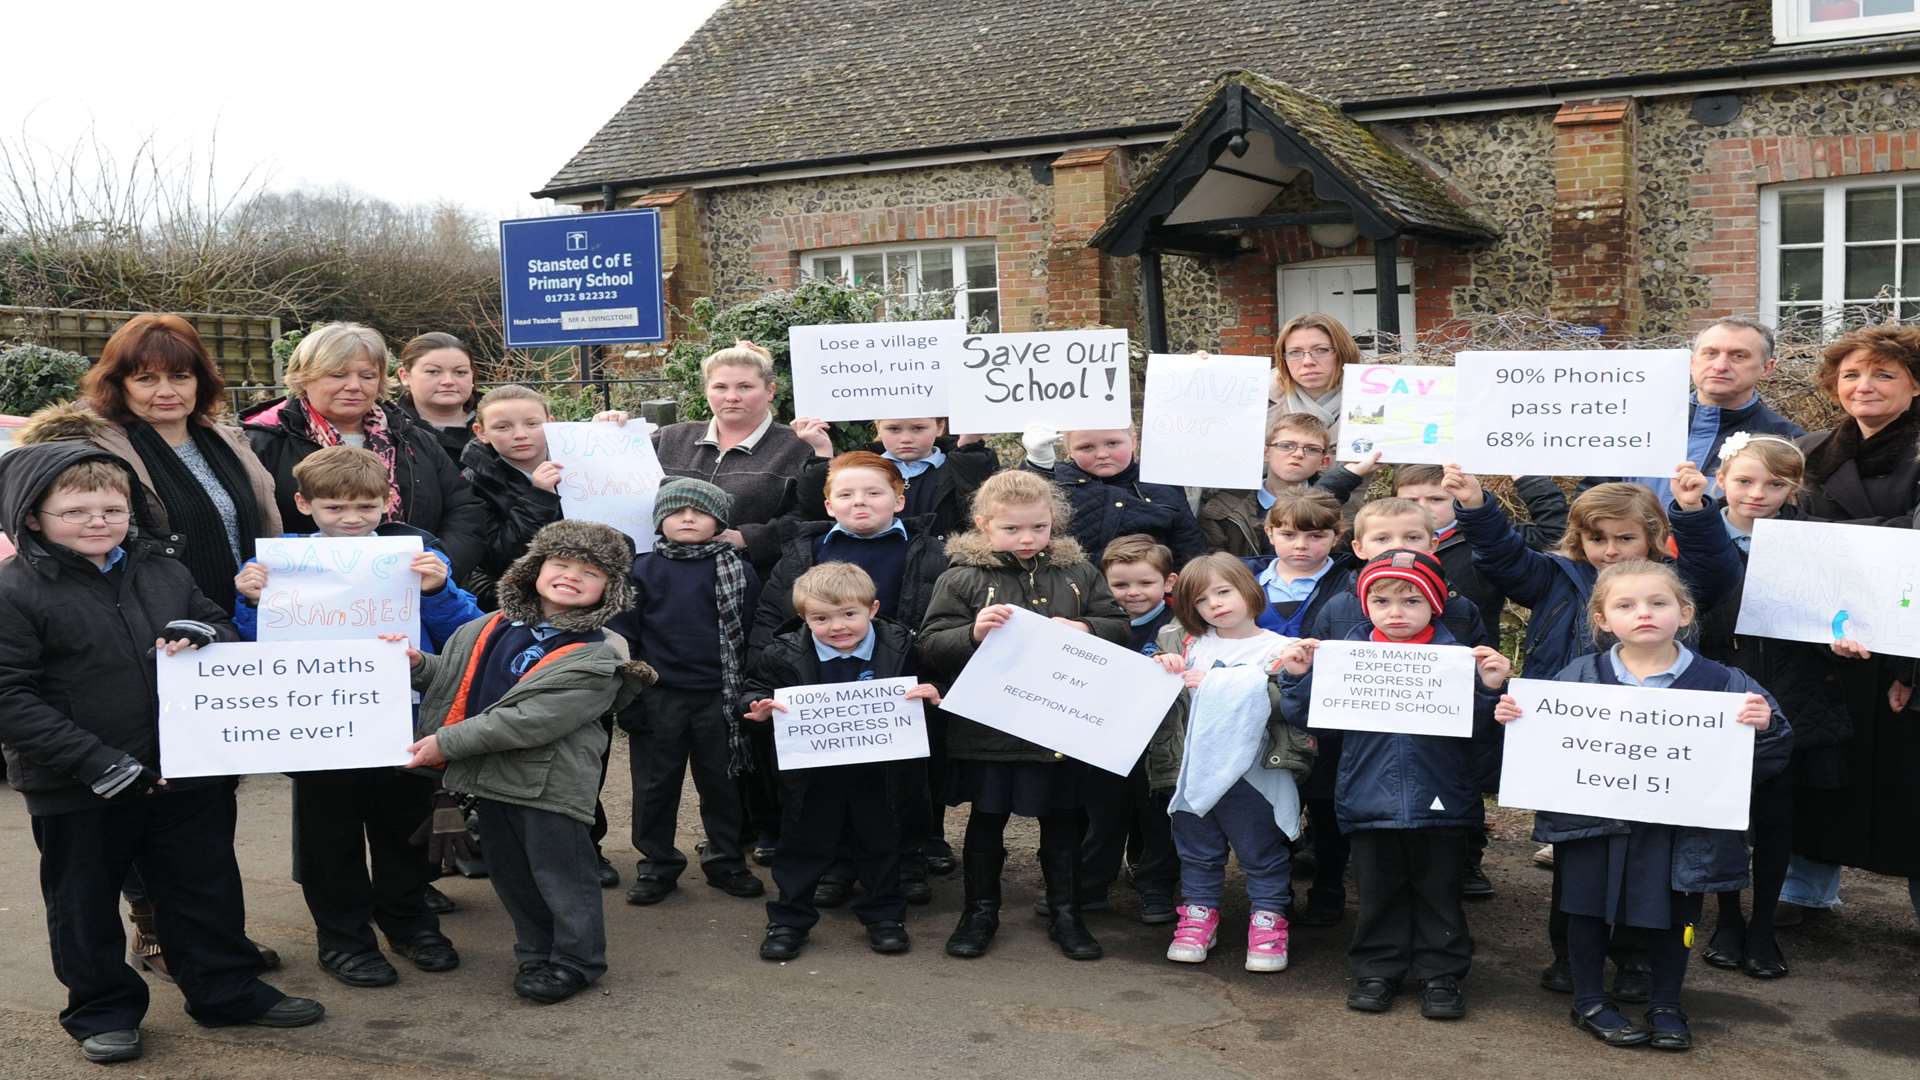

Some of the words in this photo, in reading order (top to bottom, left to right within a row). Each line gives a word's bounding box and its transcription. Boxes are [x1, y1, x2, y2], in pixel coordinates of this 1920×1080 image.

[528, 256, 588, 273] Stansted
[592, 255, 602, 269] C
[605, 253, 620, 268] of
[623, 253, 632, 267] E
[528, 275, 582, 291] Primary
[586, 271, 633, 287] School
[545, 293, 576, 303] 01732
[579, 290, 618, 301] 822323
[820, 338, 859, 350] Lose
[865, 339, 875, 349] a
[880, 334, 938, 350] village
[962, 336, 1051, 369] Save
[1066, 342, 1125, 365] our
[820, 359, 883, 375] school,
[890, 359, 925, 372] ruin
[931, 360, 941, 370] a
[1496, 368, 1545, 384] 90%
[1554, 367, 1645, 383] Phonics
[831, 382, 933, 398] community
[1511, 403, 1562, 419] pass
[1571, 398, 1627, 415] rate!
[1486, 432, 1535, 447] 68%
[1543, 431, 1651, 448] increase!
[1061, 643, 1108, 666] ROBBED
[1349, 648, 1378, 659] 48%
[1382, 649, 1440, 662] MAKING
[198, 659, 263, 677] Level
[273, 659, 287, 675] 6
[297, 656, 375, 675] Maths
[1355, 661, 1432, 674] EXPECTED
[1052, 671, 1070, 682] OF
[1067, 676, 1089, 689] MY
[1343, 673, 1424, 687] PROGRESS
[1428, 678, 1442, 688] IN
[195, 694, 278, 711] Passes
[286, 690, 324, 707] for
[331, 689, 380, 706] first
[787, 692, 831, 705] 100%
[836, 685, 906, 702] MAKING
[1349, 687, 1412, 699] WRITING
[1415, 690, 1434, 700] AT
[799, 701, 896, 722] EXPECTED
[1002, 682, 1068, 713] RECEPTION
[1067, 706, 1105, 728] PLACE
[1322, 697, 1391, 711] OFFERED
[1395, 702, 1460, 715] SCHOOL!
[1536, 698, 1611, 720] Above
[1620, 709, 1723, 729] national
[221, 726, 280, 743] time
[289, 721, 353, 740] ever!
[787, 717, 889, 737] PROGRESS
[894, 715, 911, 727] IN
[810, 732, 893, 751] WRITING!
[1562, 736, 1657, 761] average
[1667, 746, 1692, 761] at
[1576, 768, 1637, 791] Level
[1646, 776, 1670, 794] 5!
